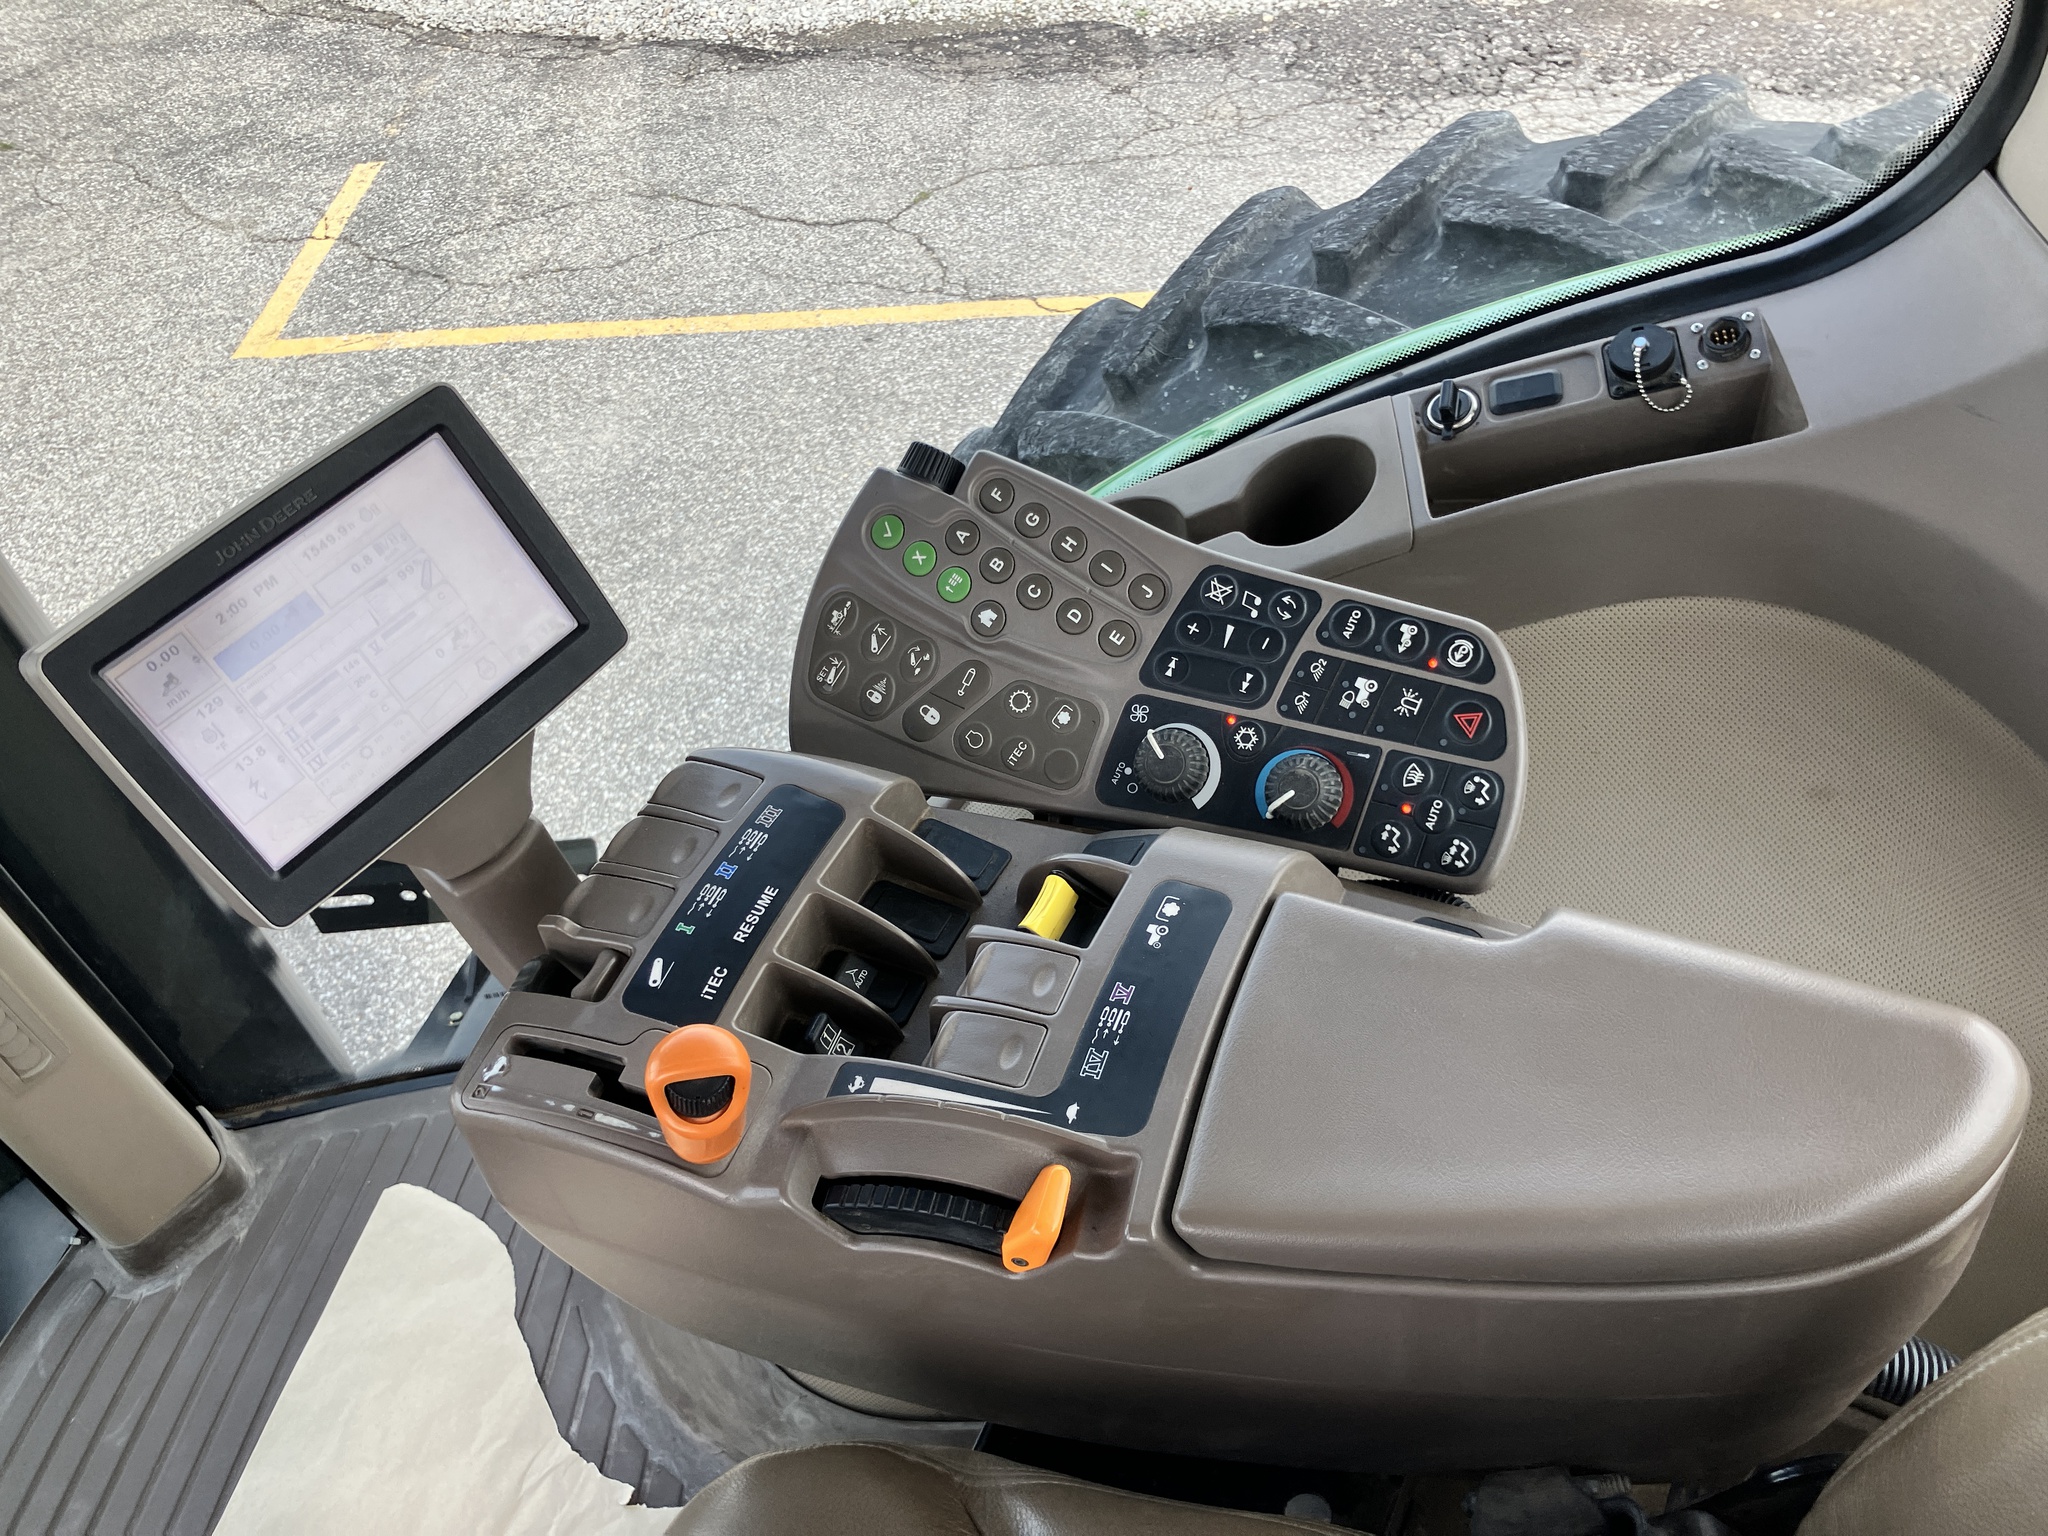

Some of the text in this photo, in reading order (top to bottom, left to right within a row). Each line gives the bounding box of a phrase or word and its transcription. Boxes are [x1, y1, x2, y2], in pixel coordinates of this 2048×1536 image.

[990, 487, 1005, 502] F
[216, 488, 318, 566] JOHN DEERE
[1025, 511, 1040, 527] G
[956, 529, 971, 544] A
[1060, 536, 1077, 552] H
[351, 554, 373, 574] 0.8
[988, 557, 1005, 572] B
[1100, 562, 1114, 574] I
[215, 575, 279, 625] 2:00 PM
[1027, 584, 1043, 599] C
[1140, 585, 1153, 599] J
[1066, 609, 1083, 624] D
[1342, 610, 1361, 639] AUTO
[249, 624, 280, 651] 0.00
[1109, 629, 1126, 646] E
[146, 644, 180, 672] 0.00
[1318, 658, 1328, 667] 2
[816, 665, 829, 683] SET
[195, 695, 224, 720] 129
[234, 746, 267, 774] 13.8
[1007, 741, 1028, 768] iTEC
[1111, 761, 1126, 786] AUTO
[755, 805, 783, 828] III
[1425, 799, 1443, 831] AUTO
[714, 861, 738, 879] II
[732, 884, 779, 943] RESUME
[700, 965, 728, 1001] iTEC
[854, 968, 869, 989] AUTO
